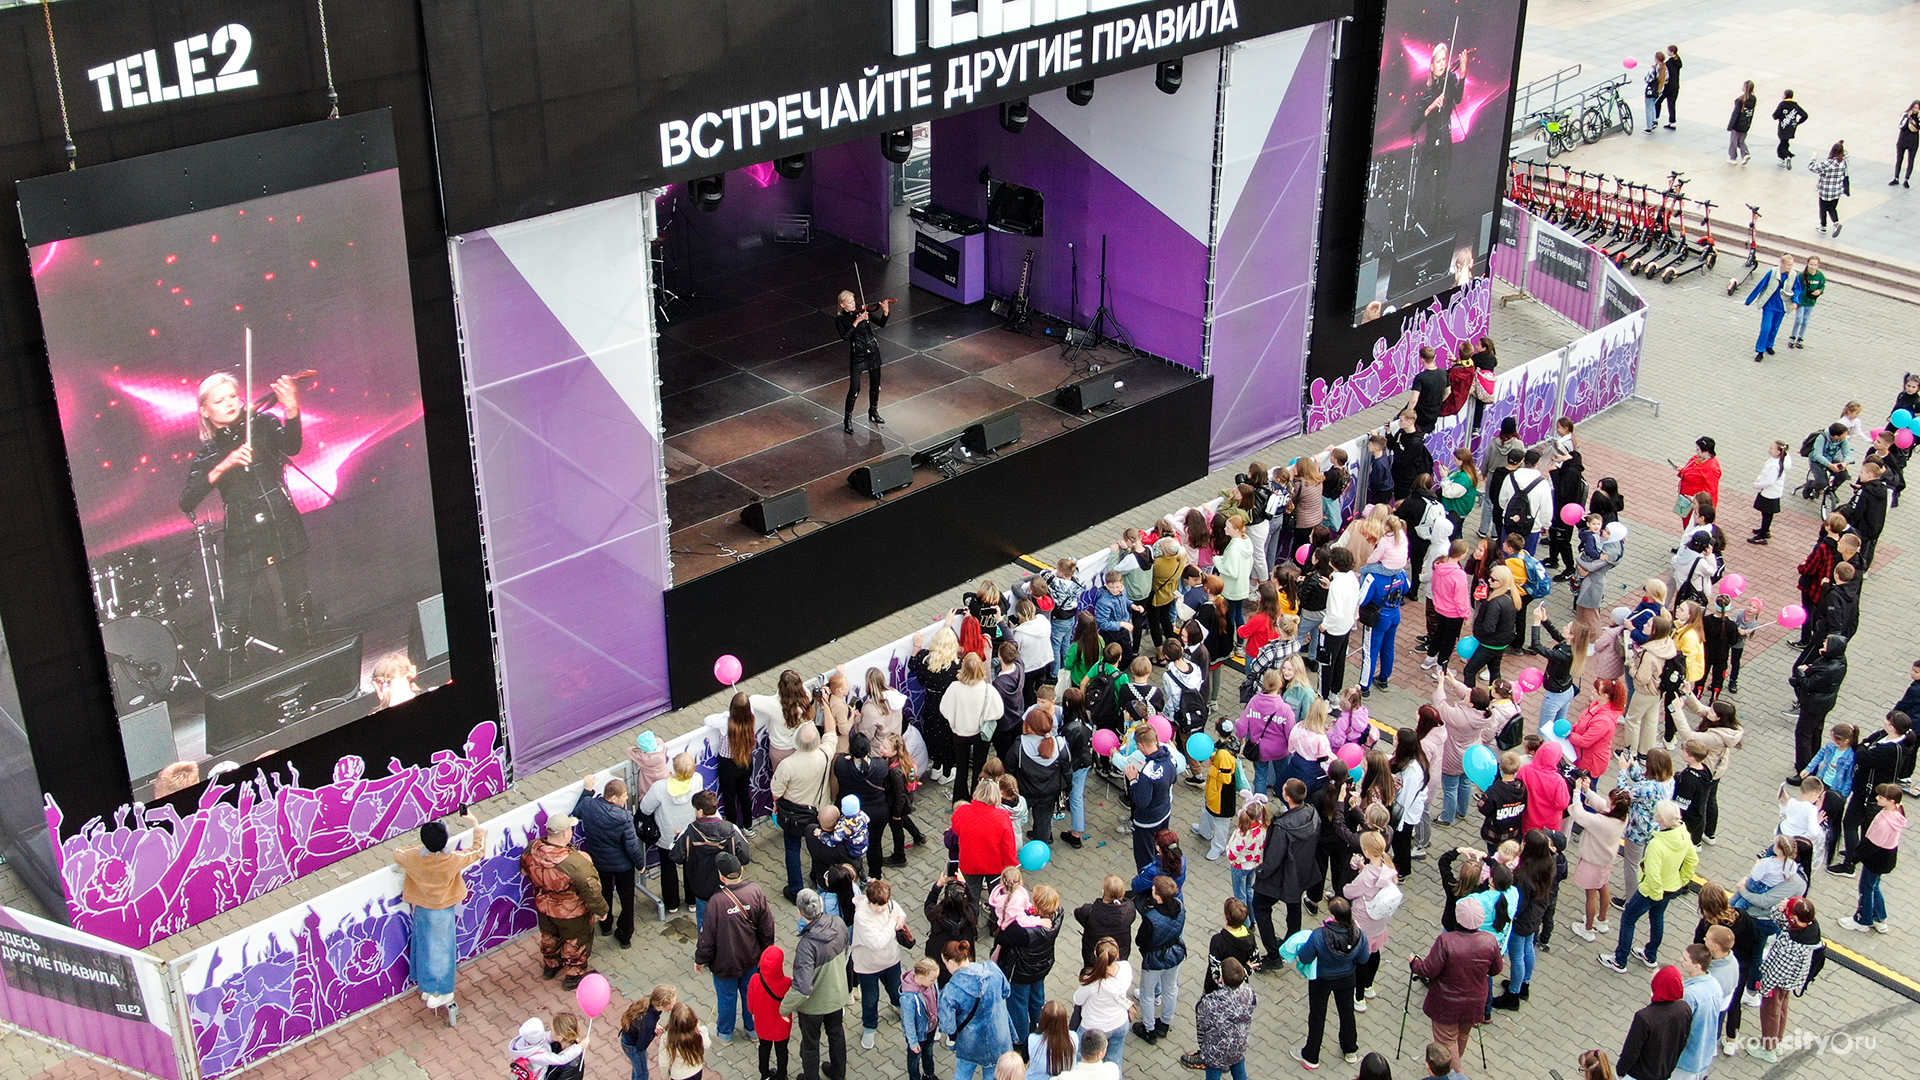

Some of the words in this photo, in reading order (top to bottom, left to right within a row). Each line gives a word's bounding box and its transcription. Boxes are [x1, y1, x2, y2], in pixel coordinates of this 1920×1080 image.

[88, 23, 259, 112] TELE2
[659, 64, 932, 168] ВСТРЕЧАЙТЕ
[944, 29, 1083, 109] ДРУГИЕ
[1091, 0, 1239, 64] ПРАВИЛА
[1537, 245, 1557, 260] ДРУГИЕ
[1556, 253, 1582, 271] ПРАВИЛА
[1538, 234, 1555, 248] ЗДЕСЬ
[2, 945, 52, 970] ДРУГИЕ
[53, 960, 120, 987] ПРАВИЛА
[115, 1003, 142, 1016] TELE2
